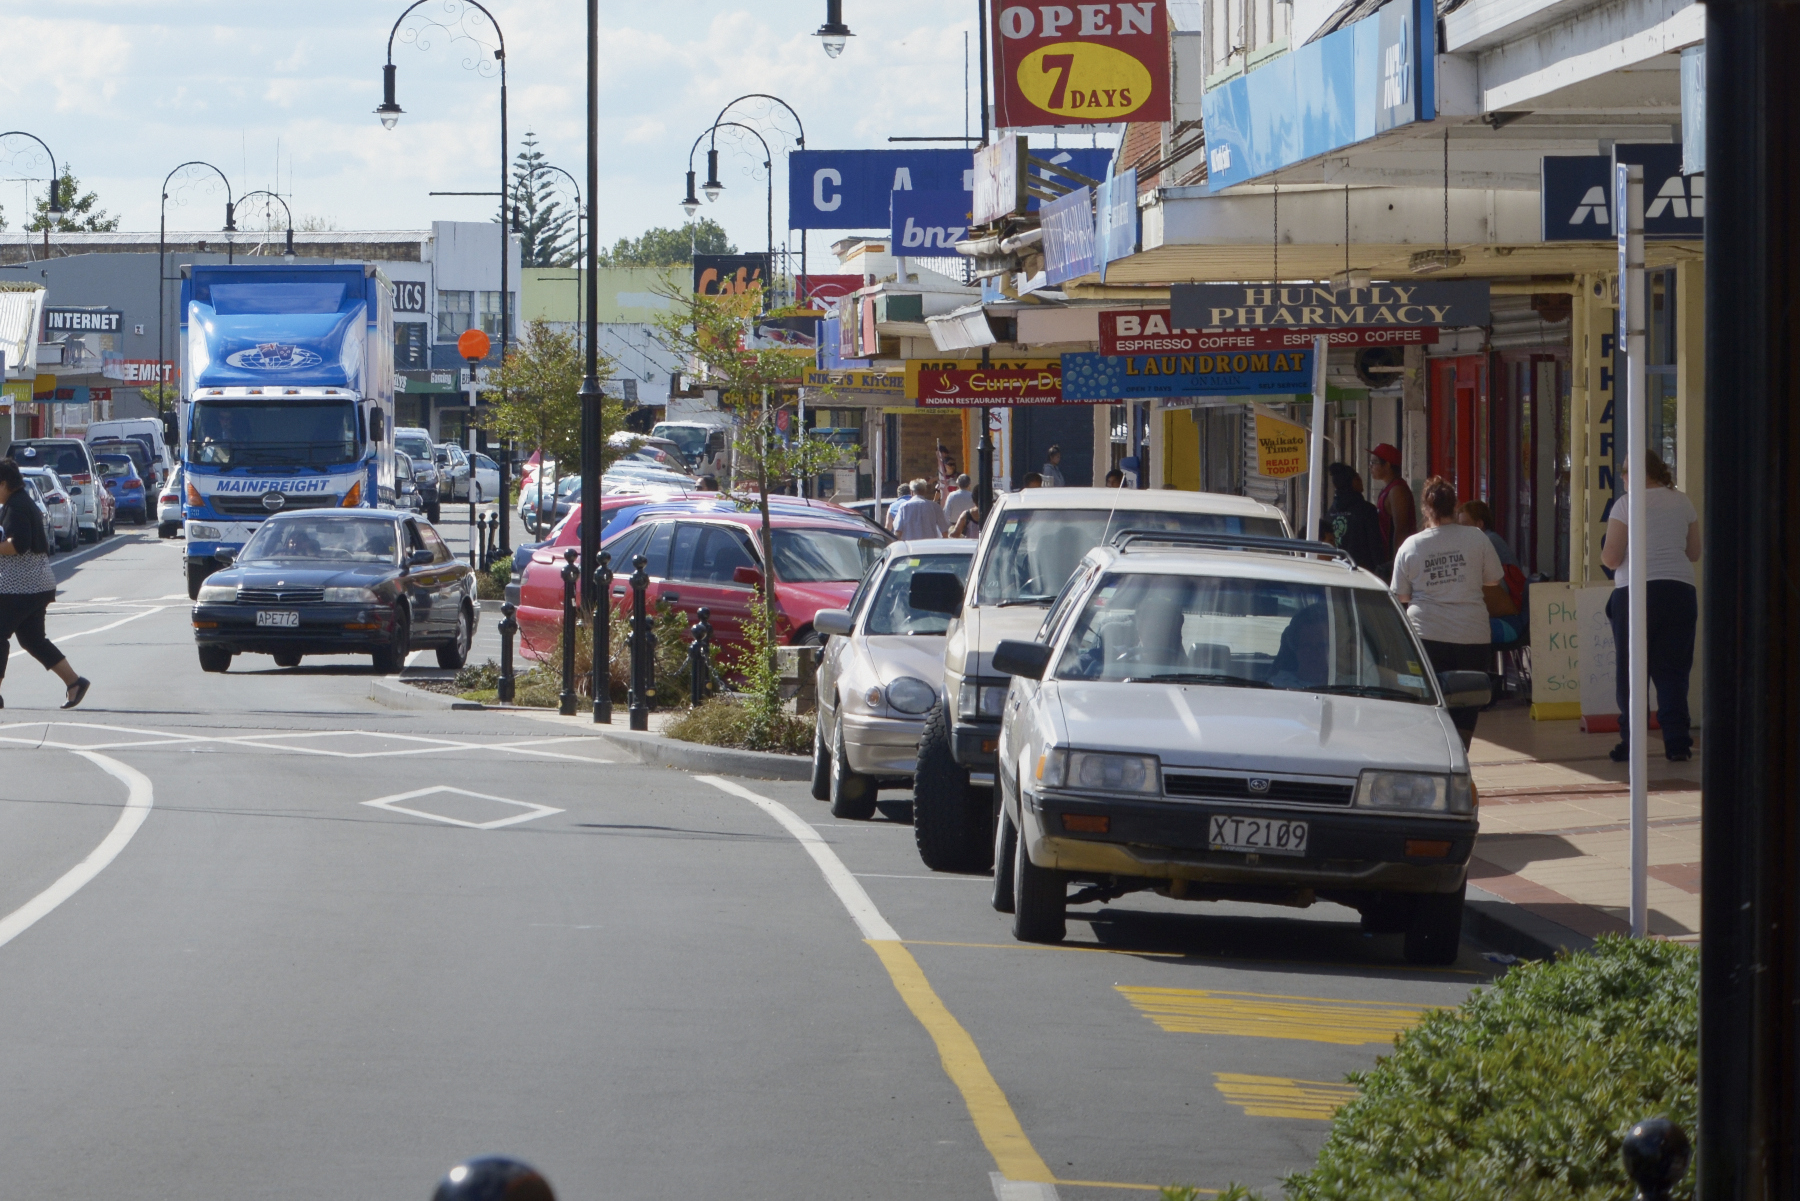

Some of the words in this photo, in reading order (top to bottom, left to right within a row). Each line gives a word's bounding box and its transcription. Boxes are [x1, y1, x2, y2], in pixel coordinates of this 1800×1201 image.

[1000, 2, 1156, 40] OPEN
[1042, 54, 1074, 110] 7
[1070, 88, 1132, 109] DAYS
[902, 218, 968, 248] bnz
[1242, 286, 1418, 306] HUNTLY
[48, 312, 120, 330] INTERNET
[1208, 304, 1452, 326] PHARMACY
[1116, 338, 1192, 351] ESPRESSO
[1198, 336, 1255, 349] COFFEE
[1283, 332, 1358, 346] ESPRSSO
[1364, 330, 1422, 342] COFFEE
[122, 362, 174, 382] EMIST
[1125, 352, 1306, 376] LAUNDROMAT
[808, 373, 854, 386] NIKI'S
[862, 375, 906, 388] KITCHE
[968, 372, 1030, 396] Curry
[1037, 372, 1062, 390] De
[1190, 376, 1208, 386] ON
[1210, 375, 1241, 386] MAIN
[1258, 382, 1276, 390] SELF
[1276, 381, 1308, 389] SERVICE
[926, 396, 954, 405] INDIAN
[956, 396, 1006, 405] RESTAURANT
[1007, 396, 1014, 405] &
[1016, 396, 1058, 404] TAKEAWAY
[1258, 436, 1304, 447] Waikato
[1265, 445, 1298, 454] Times
[1266, 458, 1290, 467] READ
[1266, 466, 1299, 474] TODAY!
[216, 479, 330, 493] MAINFREIGHT
[1424, 556, 1447, 568] DAVID
[1448, 554, 1465, 564] TUA
[1430, 568, 1460, 580] BELT
[258, 612, 298, 626] APE772
[1550, 632, 1579, 652] KIC
[1212, 818, 1306, 849] XT2109
